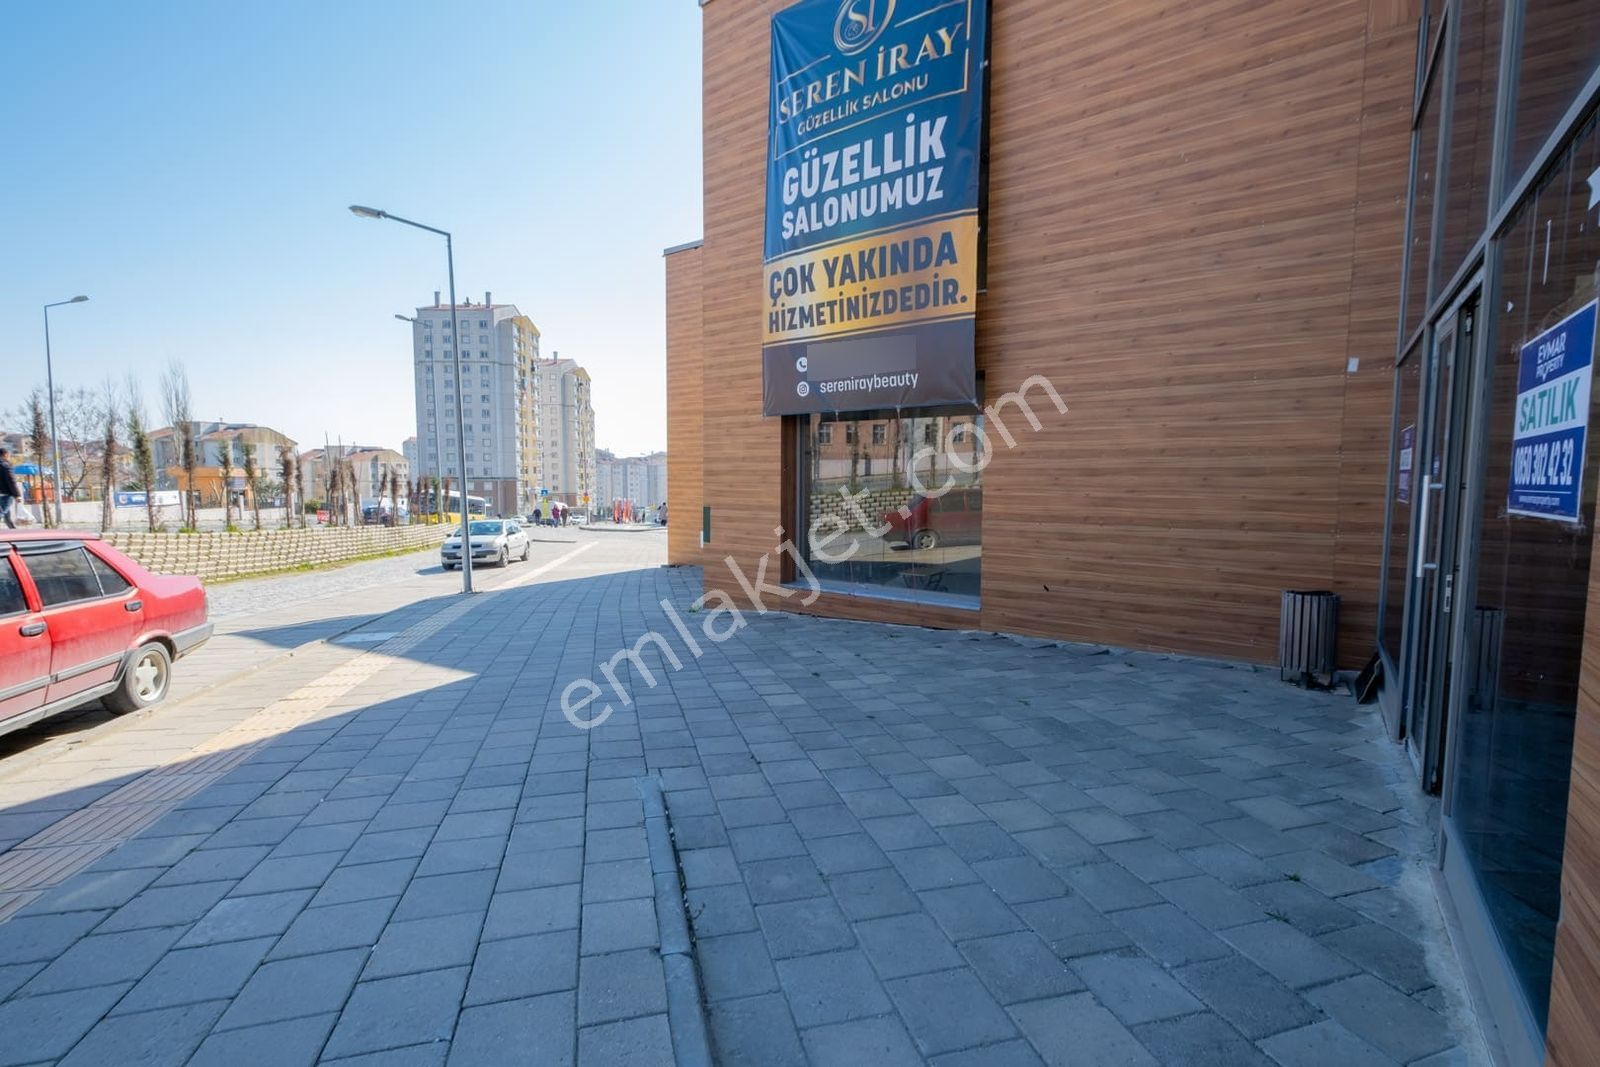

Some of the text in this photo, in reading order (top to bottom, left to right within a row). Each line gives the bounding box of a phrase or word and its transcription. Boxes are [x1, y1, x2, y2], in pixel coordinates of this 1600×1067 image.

[778, 22, 964, 124] SEREN İRAY
[797, 73, 929, 136] GÜZELLİK SALONU
[782, 112, 948, 206] GÜZELLİK
[781, 166, 944, 240] SALONUMUZ
[769, 231, 958, 307] ÇOK YAKINDA
[768, 272, 968, 334] HİZMETİNİZDEDİR.
[819, 371, 919, 394] sereniraybeauty
[1519, 376, 1581, 433] SATILIK
[1531, 442, 1548, 486] 302
[1547, 440, 1561, 486] 42
[1560, 437, 1575, 486] 32
